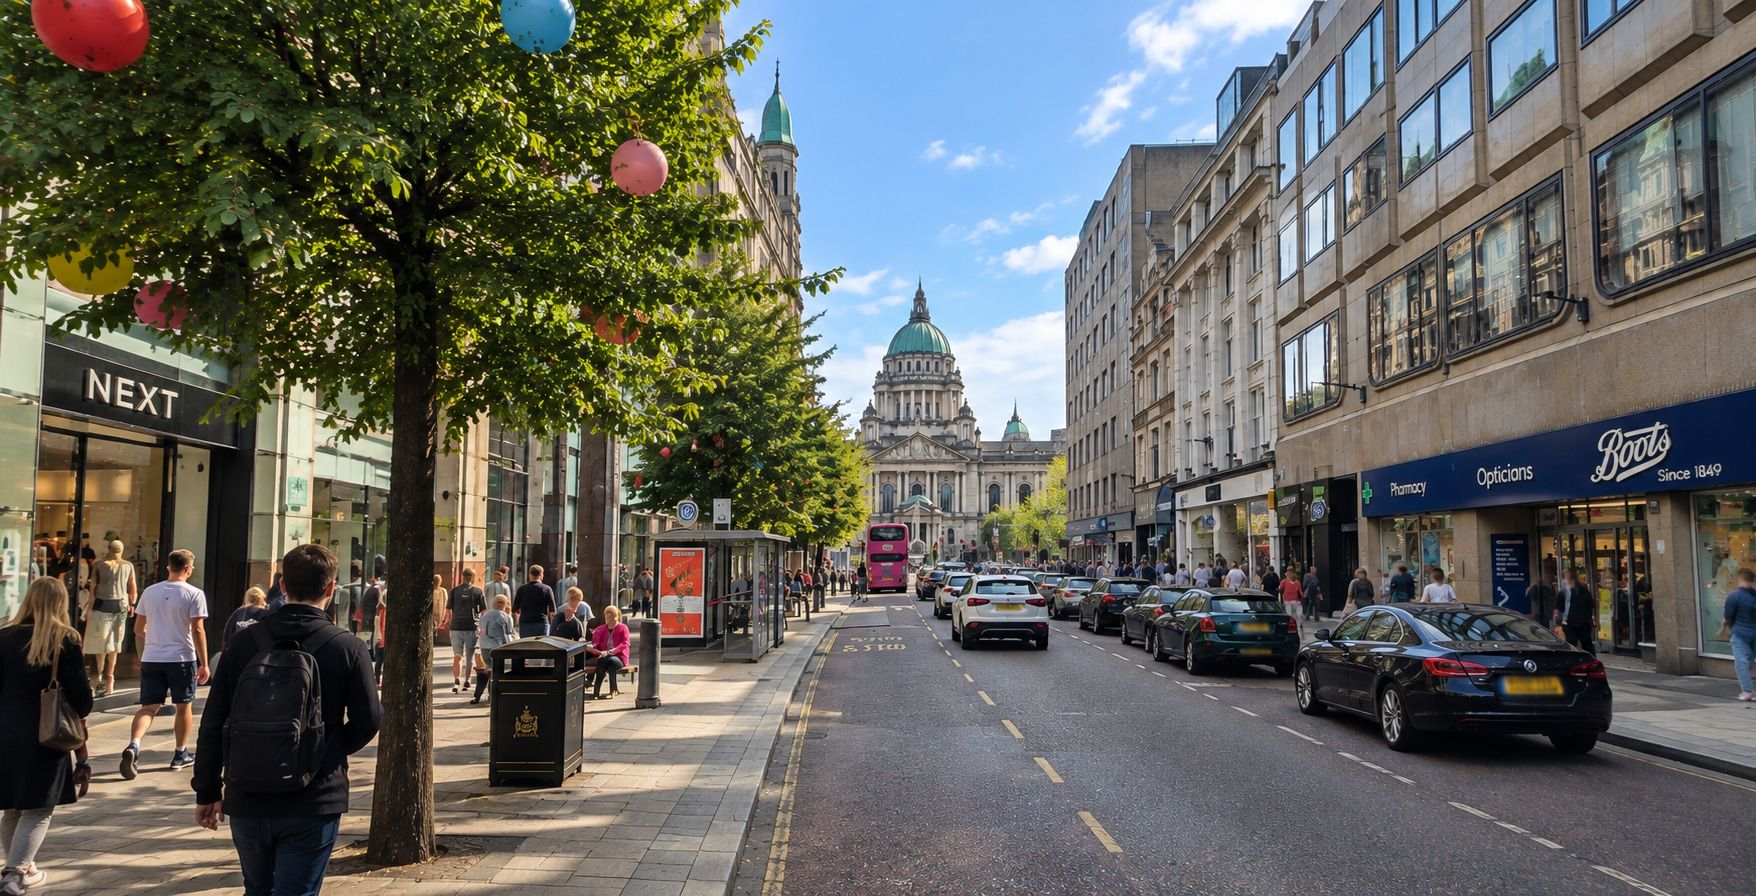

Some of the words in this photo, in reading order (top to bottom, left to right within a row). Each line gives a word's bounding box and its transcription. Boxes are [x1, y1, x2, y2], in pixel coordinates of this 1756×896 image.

[86, 368, 179, 419] NEXT
[1590, 421, 1672, 483] Boots
[1477, 463, 1533, 489] Opticians
[1657, 468, 1691, 482] Since
[1694, 463, 1722, 479] 1849
[1390, 481, 1427, 497] Pharmacy
